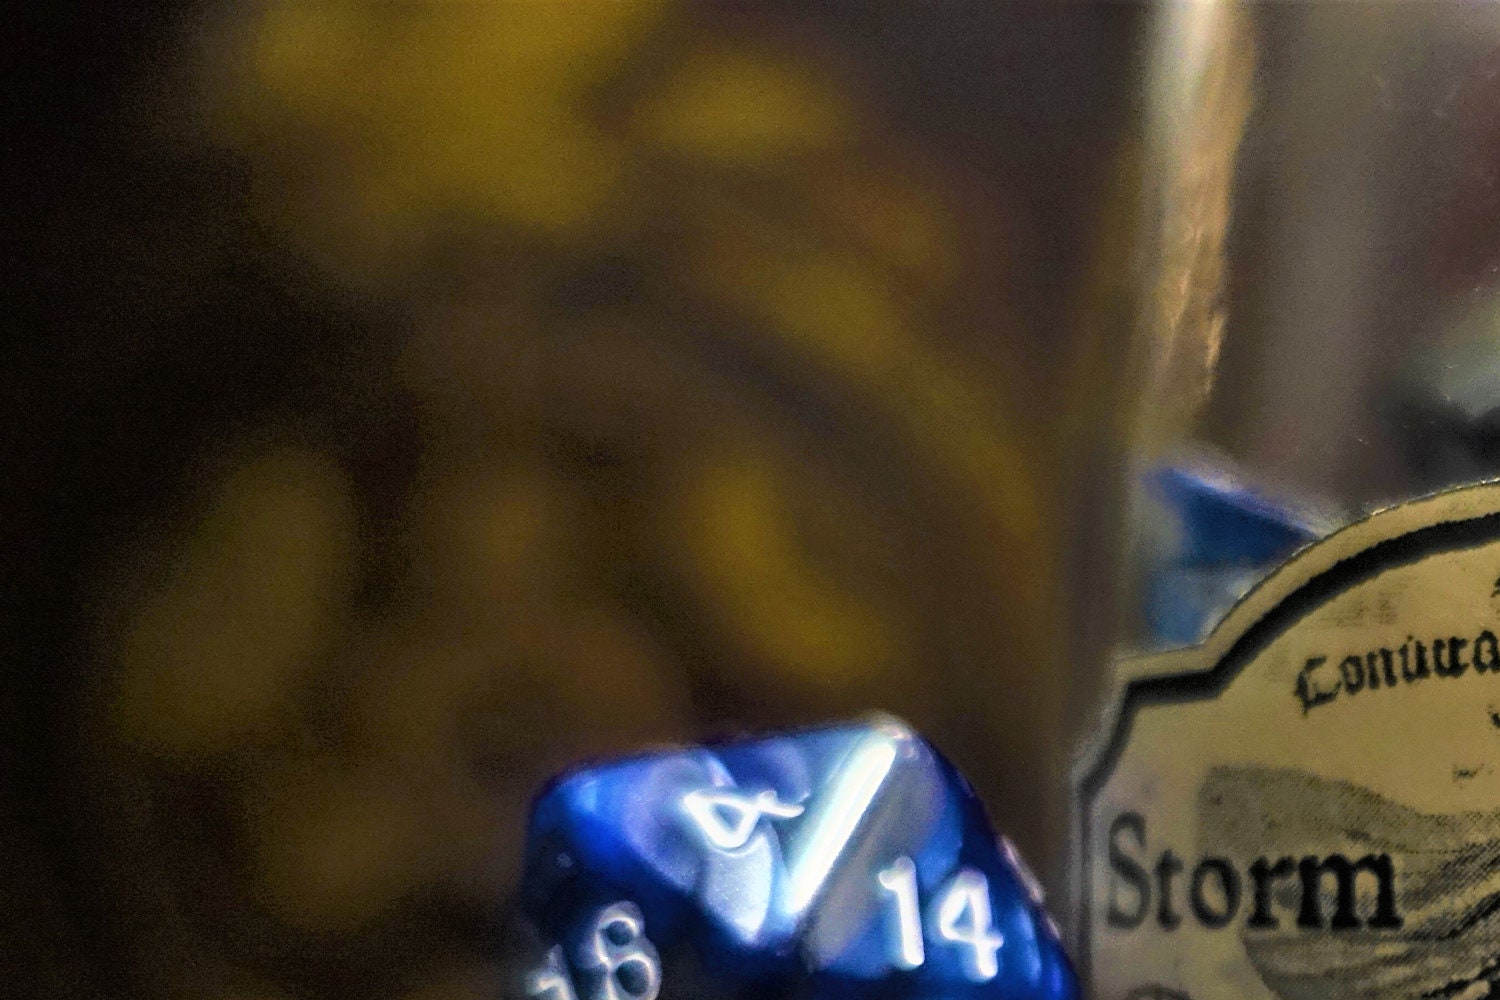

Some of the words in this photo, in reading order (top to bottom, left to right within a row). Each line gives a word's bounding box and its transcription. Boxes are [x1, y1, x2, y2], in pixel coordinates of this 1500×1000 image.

[683, 788, 806, 852] 4
[1107, 810, 1405, 933] Storm
[876, 855, 1003, 982] 14
